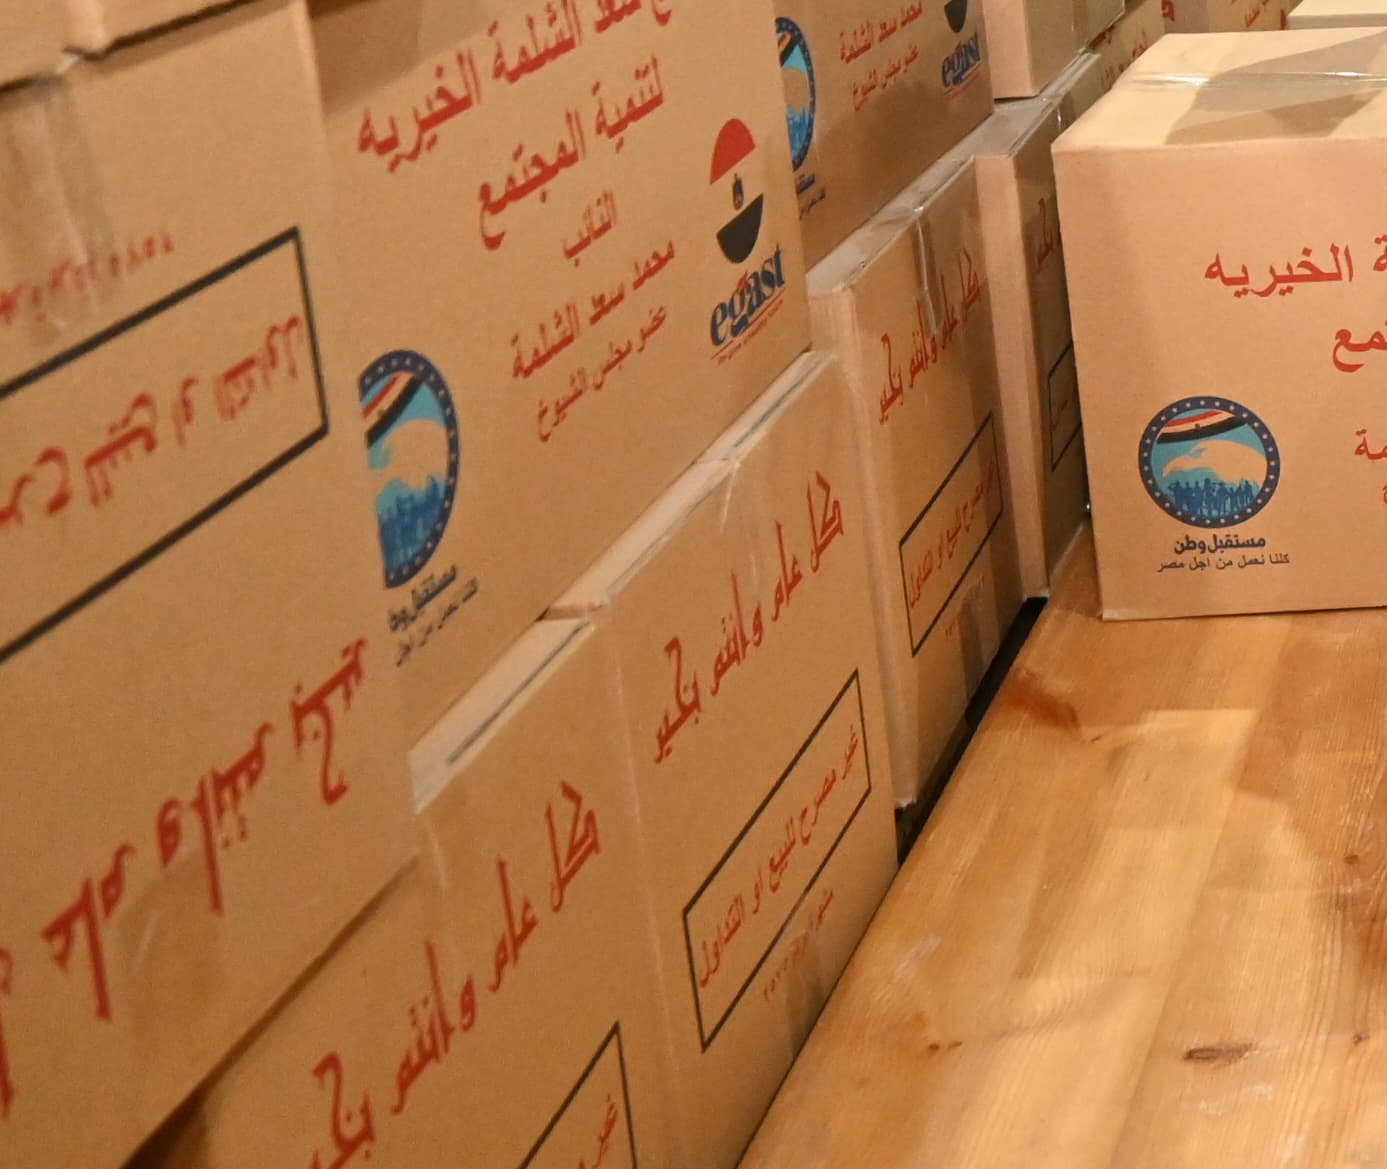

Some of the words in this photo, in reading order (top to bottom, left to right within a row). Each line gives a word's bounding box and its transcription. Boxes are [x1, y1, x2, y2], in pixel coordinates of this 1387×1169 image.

[594, 53, 665, 152] لتنمية
[478, 107, 587, 251] المجتمع
[772, 519, 803, 623] عام
[806, 470, 844, 574] كل
[1174, 534, 1207, 554] وطن
[1207, 534, 1267, 554] مستقبل
[654, 635, 702, 765] بخير
[544, 780, 601, 913] كل
[487, 856, 540, 993] عام
